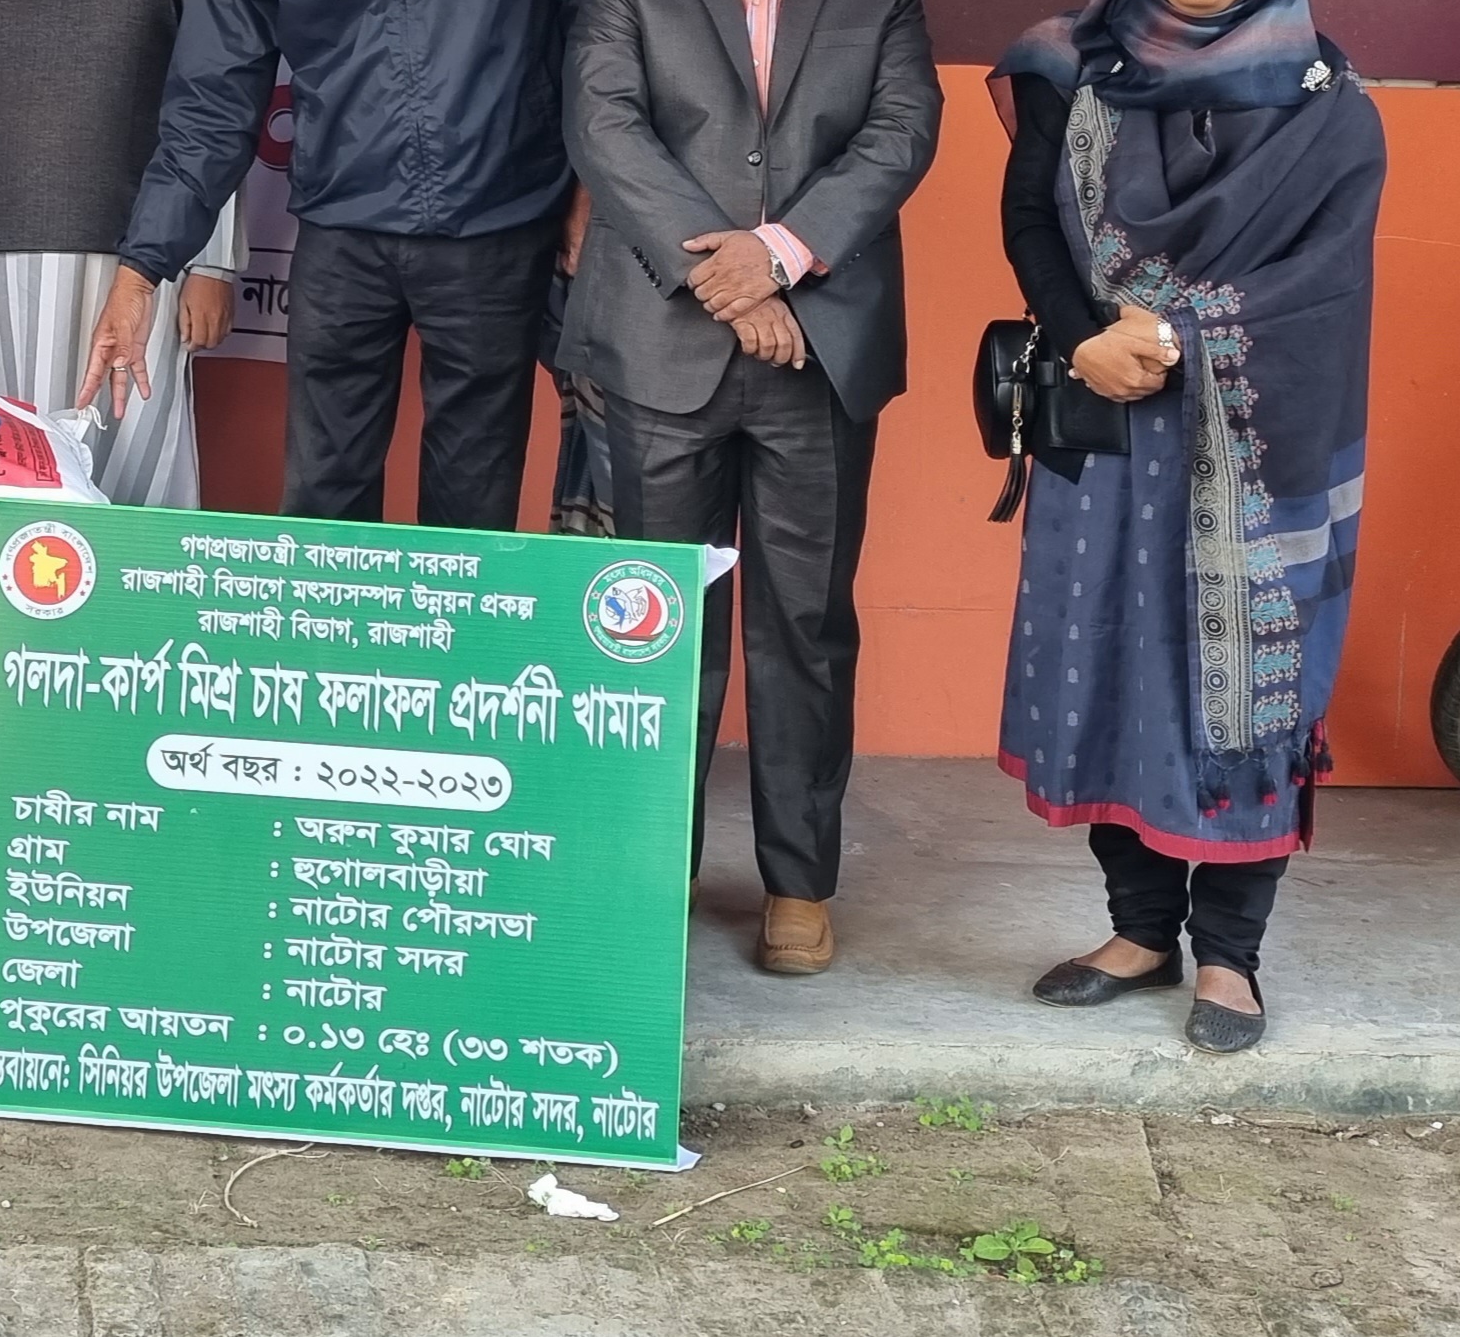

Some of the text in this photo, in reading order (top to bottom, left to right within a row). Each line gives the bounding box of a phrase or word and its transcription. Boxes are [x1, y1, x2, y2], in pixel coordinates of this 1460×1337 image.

[180, 533, 482, 579] গণপ্রজাতন্ত্রী বাংলাদেশ সরকার
[120, 566, 537, 622] রাজশাহী বিভাগে মৎস্যসম্পদ উন্নয়ন প্রকল্প
[197, 606, 455, 653] রাজশাহী বিভাগ, রাজশাহী
[3, 638, 667, 752] গলদা-কার্প মিশ্র চাষ ফলাফল প্রদর্শনী খামার
[160, 743, 214, 777] অর্থ
[220, 754, 283, 786] বছর
[316, 761, 504, 803] ২০২২-২০২৩
[5, 833, 71, 866] গ্রাম
[10, 788, 98, 828] চাষীর
[103, 801, 165, 832] নাম
[294, 817, 382, 848] অরুন
[387, 823, 475, 859] কুমার
[484, 830, 557, 862] ঘোষ
[4, 868, 134, 912] ইউনিয়ন
[289, 892, 393, 931] নাটোর
[402, 899, 538, 943] পৌরসভা
[1, 908, 137, 953] উপজেলা
[284, 933, 388, 971] নাটোর
[394, 945, 469, 977] সদর
[2, 957, 83, 989] জেলা
[283, 973, 388, 1012] নাটোর
[0, 996, 112, 1036] পুকুরের
[117, 1006, 235, 1043] আয়তন
[282, 1022, 365, 1050] ০.১৩
[378, 1027, 430, 1061] হেঃ
[442, 1029, 509, 1067] (৩৩
[518, 1036, 619, 1080] শতক)
[77, 1042, 151, 1099] সিনিয়র
[155, 1048, 243, 1108] উপজেলা
[246, 1069, 300, 1112] মৎস্য
[303, 1061, 396, 1119] কর্মকর্তার
[399, 1078, 452, 1133] দপ্তর,
[459, 1074, 527, 1130] নাটোর
[531, 1091, 584, 1143] সদর,
[591, 1086, 660, 1141] নাটোর
